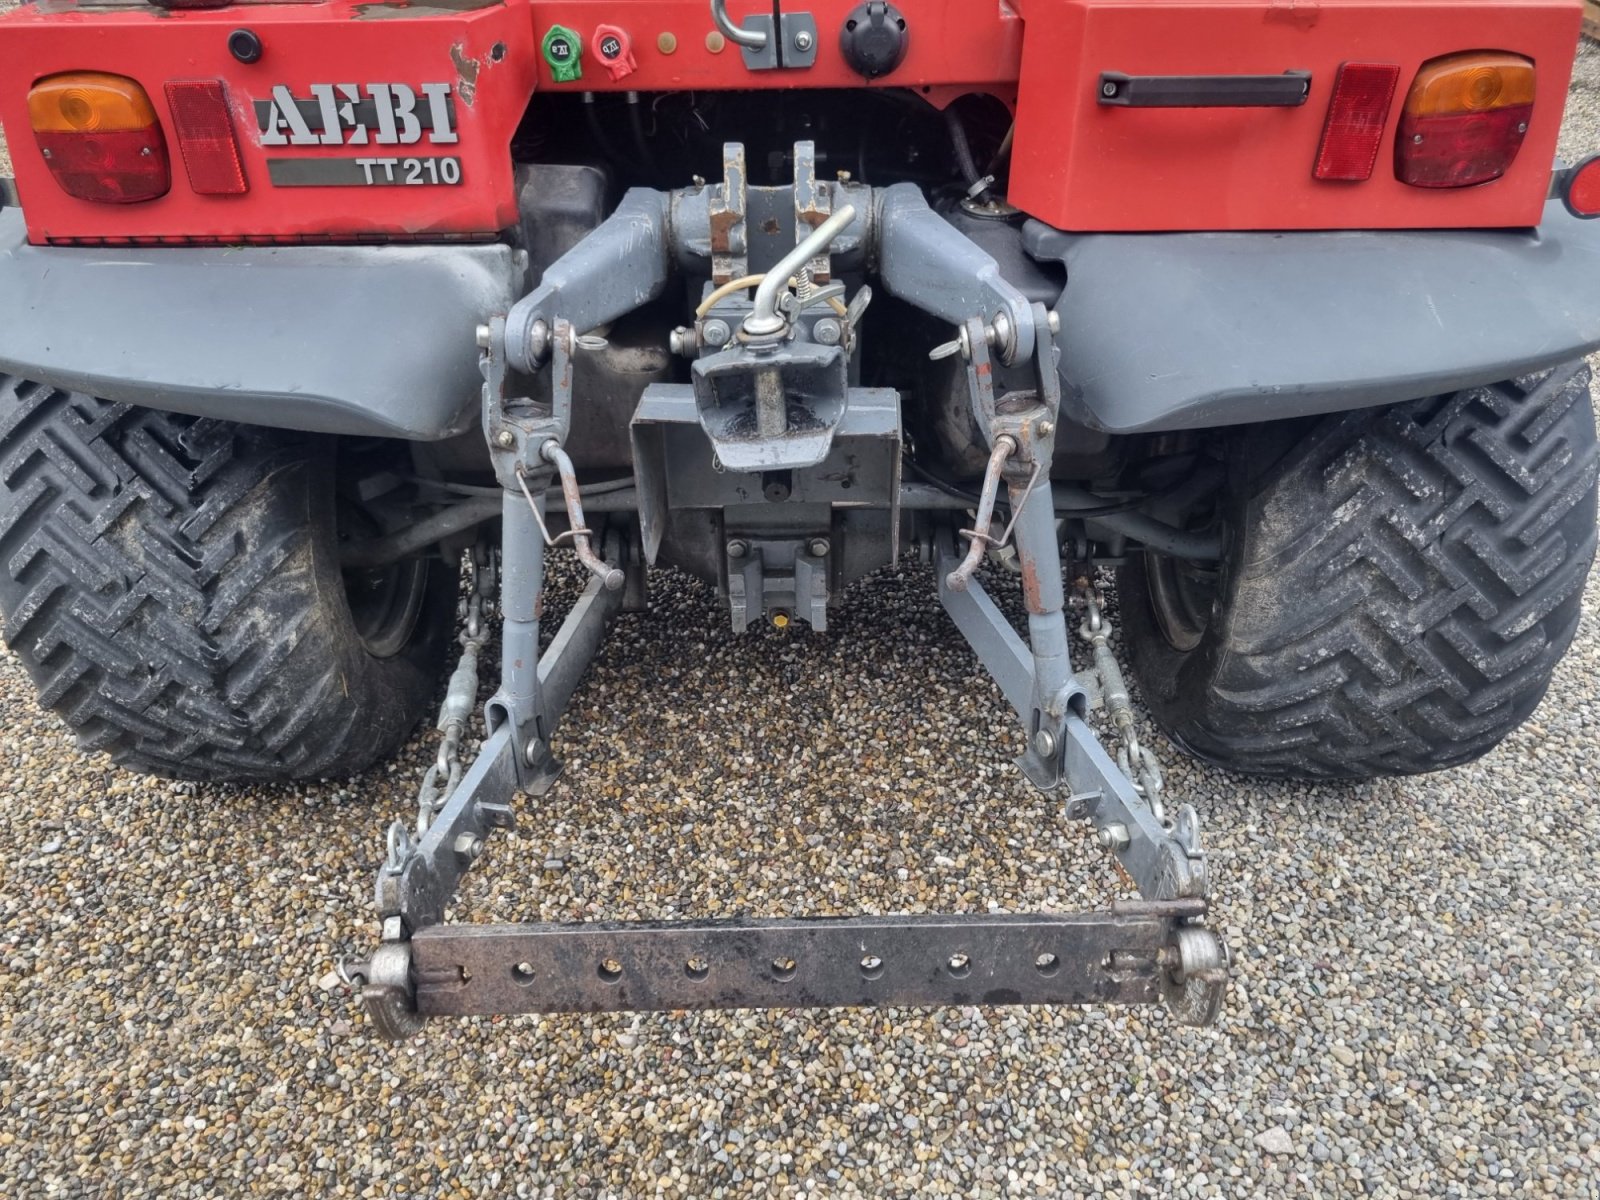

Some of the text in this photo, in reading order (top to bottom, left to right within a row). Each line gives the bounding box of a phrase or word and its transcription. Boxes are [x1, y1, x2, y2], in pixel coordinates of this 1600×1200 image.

[259, 83, 458, 145] AEBI
[355, 157, 460, 184] TT 210
